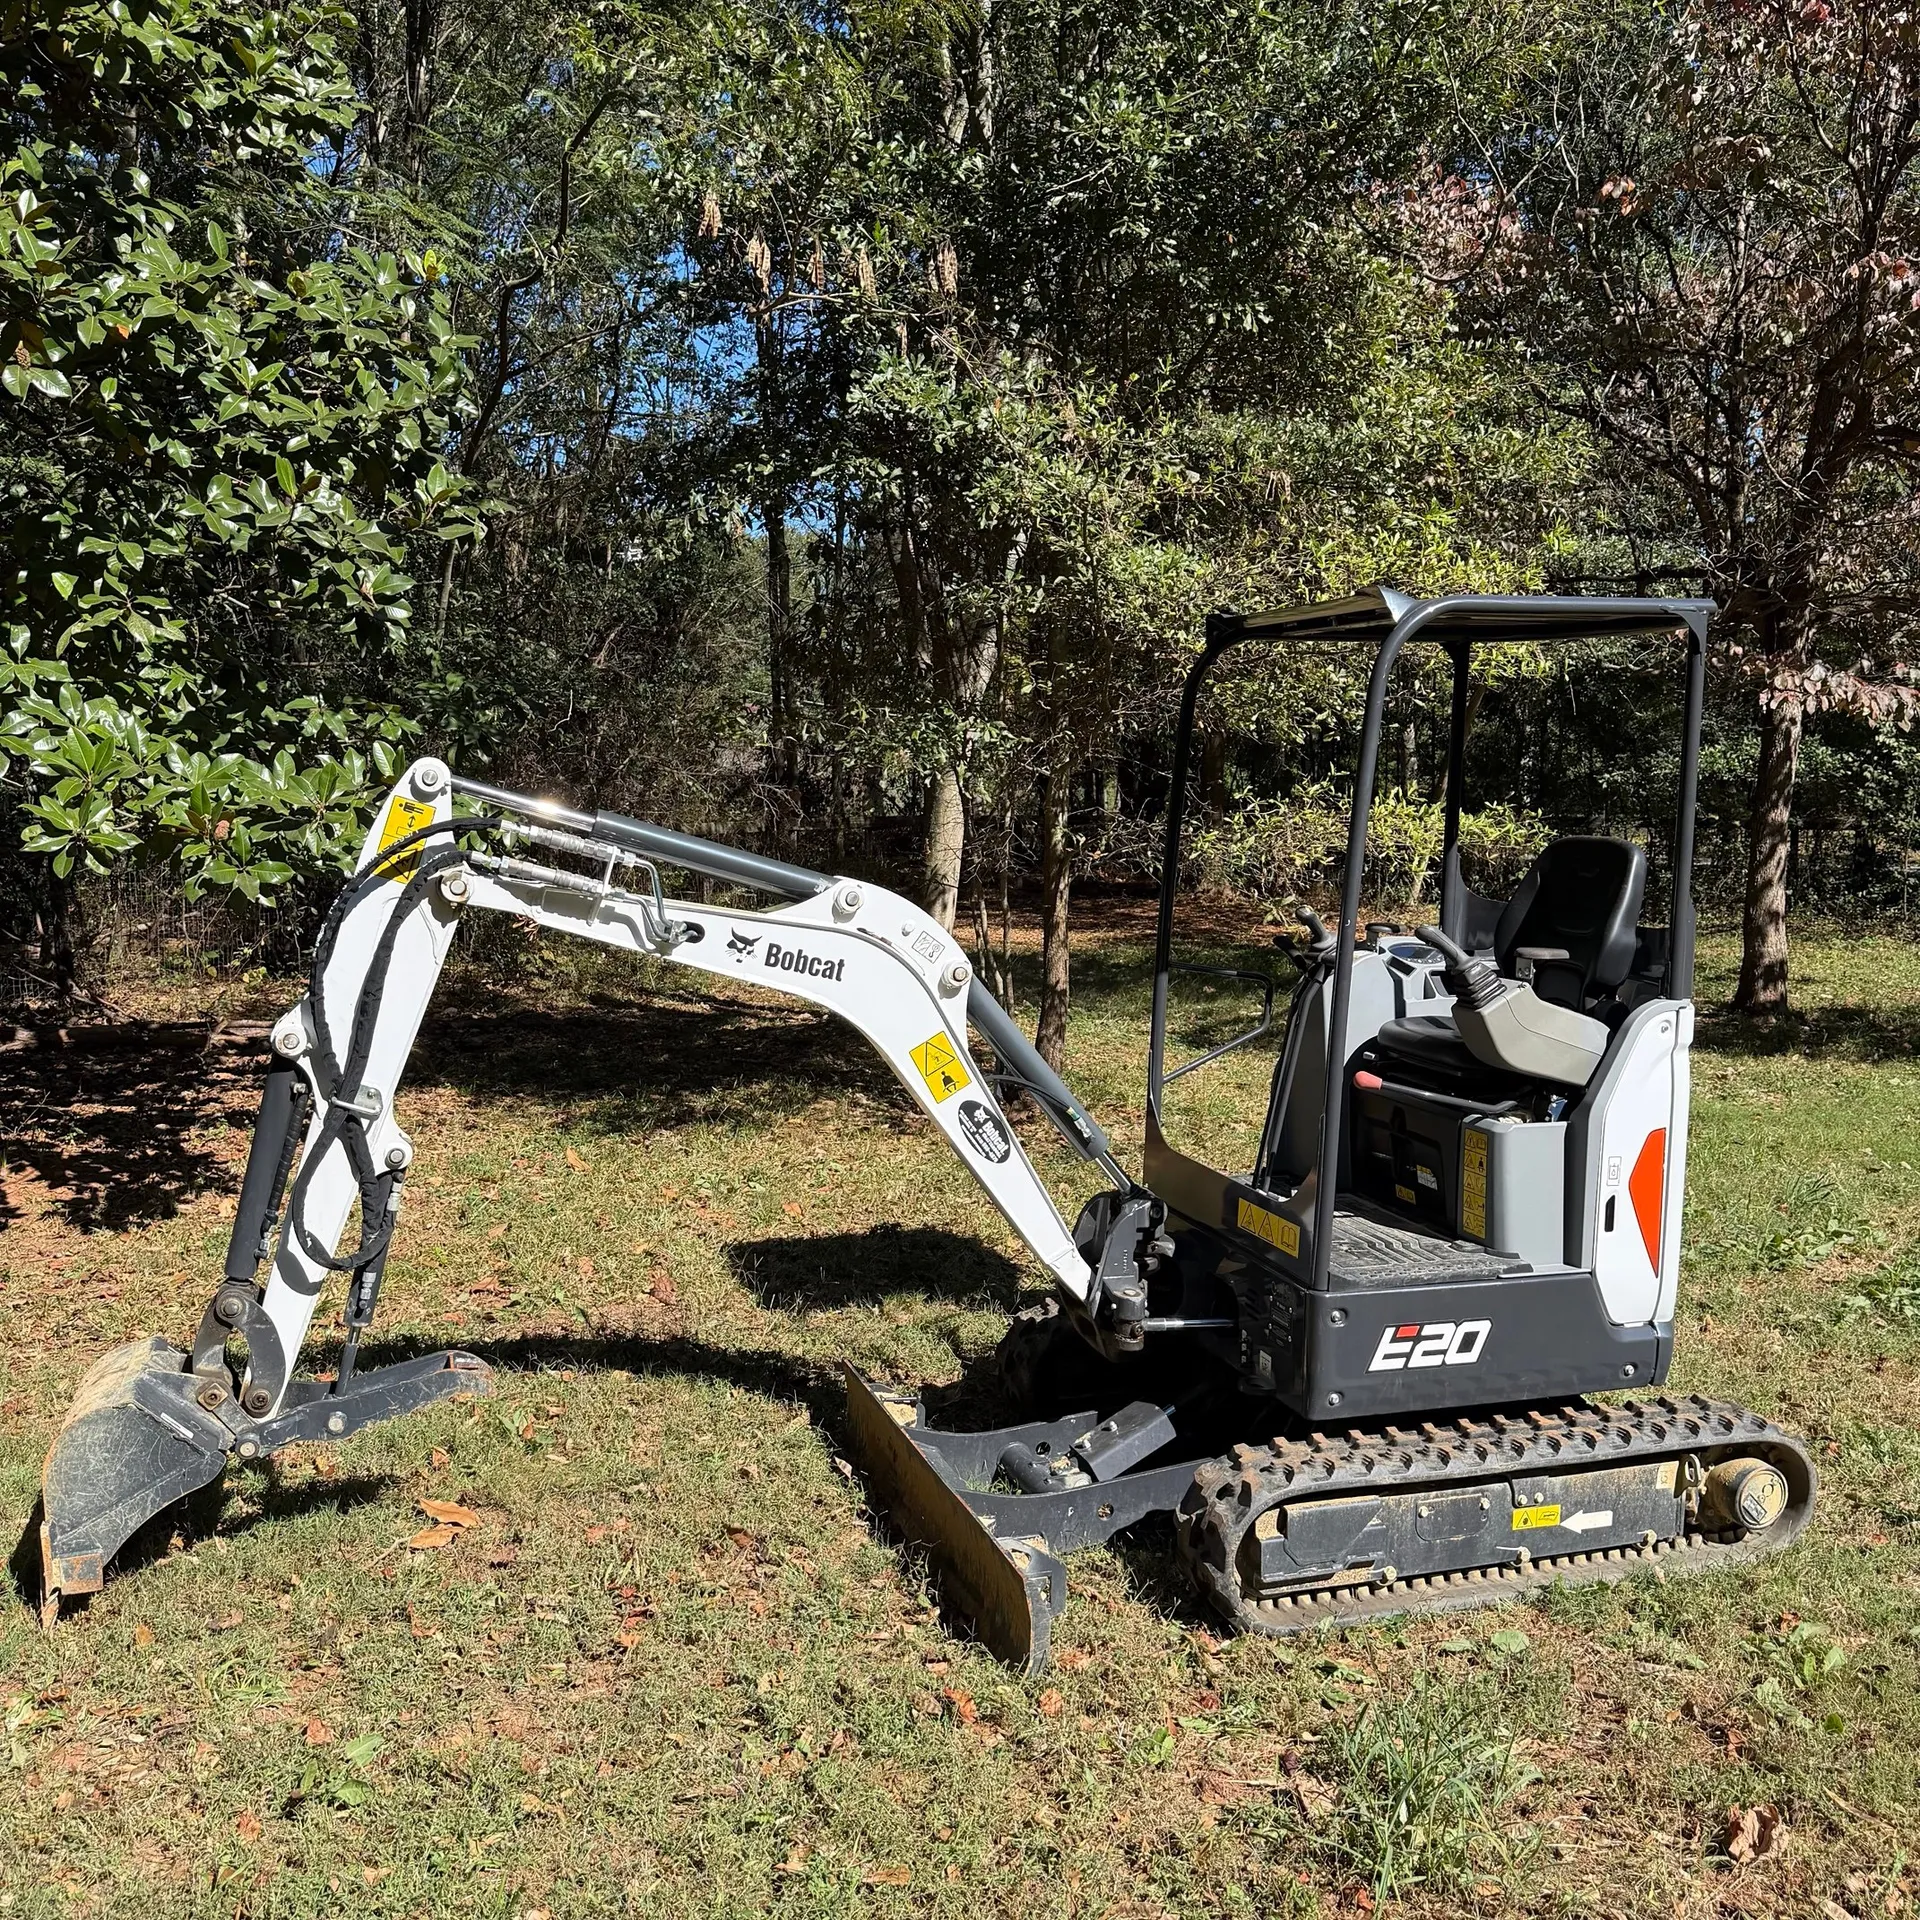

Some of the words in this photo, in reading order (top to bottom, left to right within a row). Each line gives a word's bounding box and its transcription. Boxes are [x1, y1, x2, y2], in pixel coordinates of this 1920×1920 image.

[764, 942, 845, 982] Bobcat
[982, 1120, 1009, 1153] Bobcat
[1367, 1319, 1493, 1372] E20
